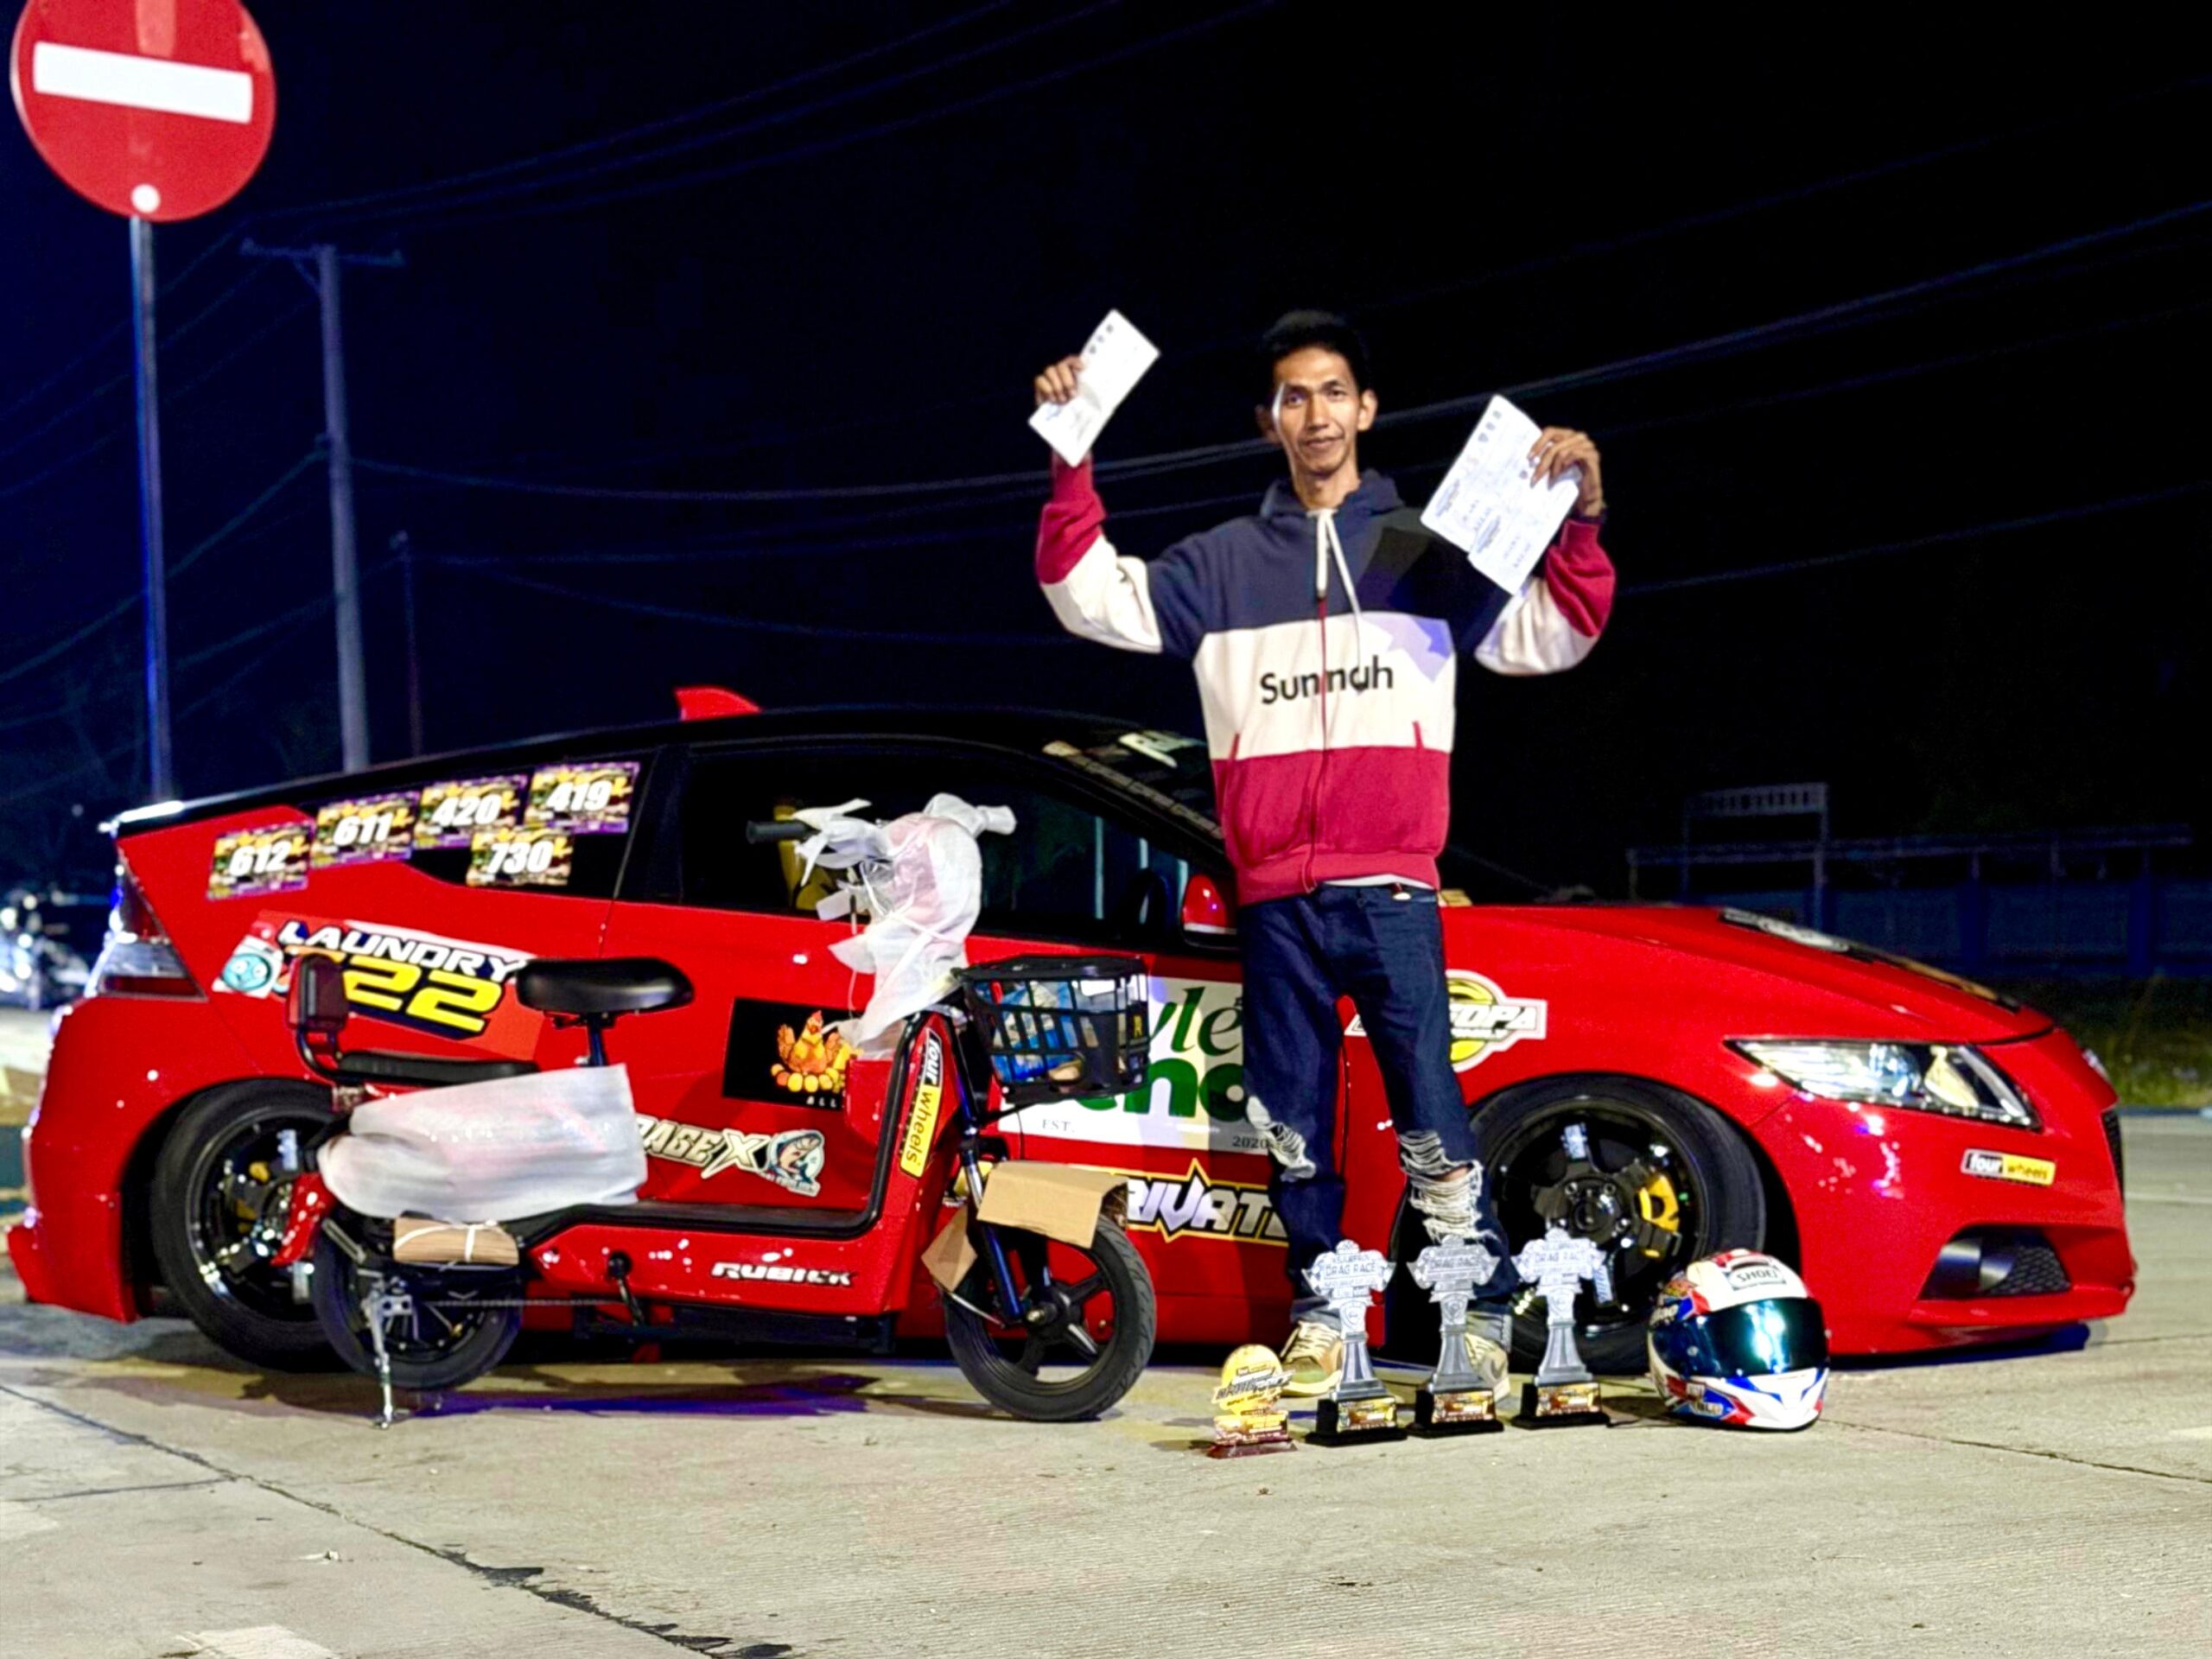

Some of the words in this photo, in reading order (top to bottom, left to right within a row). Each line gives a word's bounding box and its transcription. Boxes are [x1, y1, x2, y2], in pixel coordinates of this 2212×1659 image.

[1260, 654, 1393, 705] Sunnah
[431, 793, 503, 827] 420
[546, 780, 613, 812] 419
[334, 813, 394, 847] 611
[228, 840, 292, 877] 612
[486, 841, 555, 874] 730
[277, 920, 527, 983] LAUNDRY
[343, 955, 503, 1033] 22
[925, 1039, 941, 1084] four
[906, 1091, 933, 1164] wheels
[1231, 1135, 1269, 1148] 2020
[1353, 1262, 1376, 1274] RACE
[1736, 1268, 1779, 1283] SHOEI
